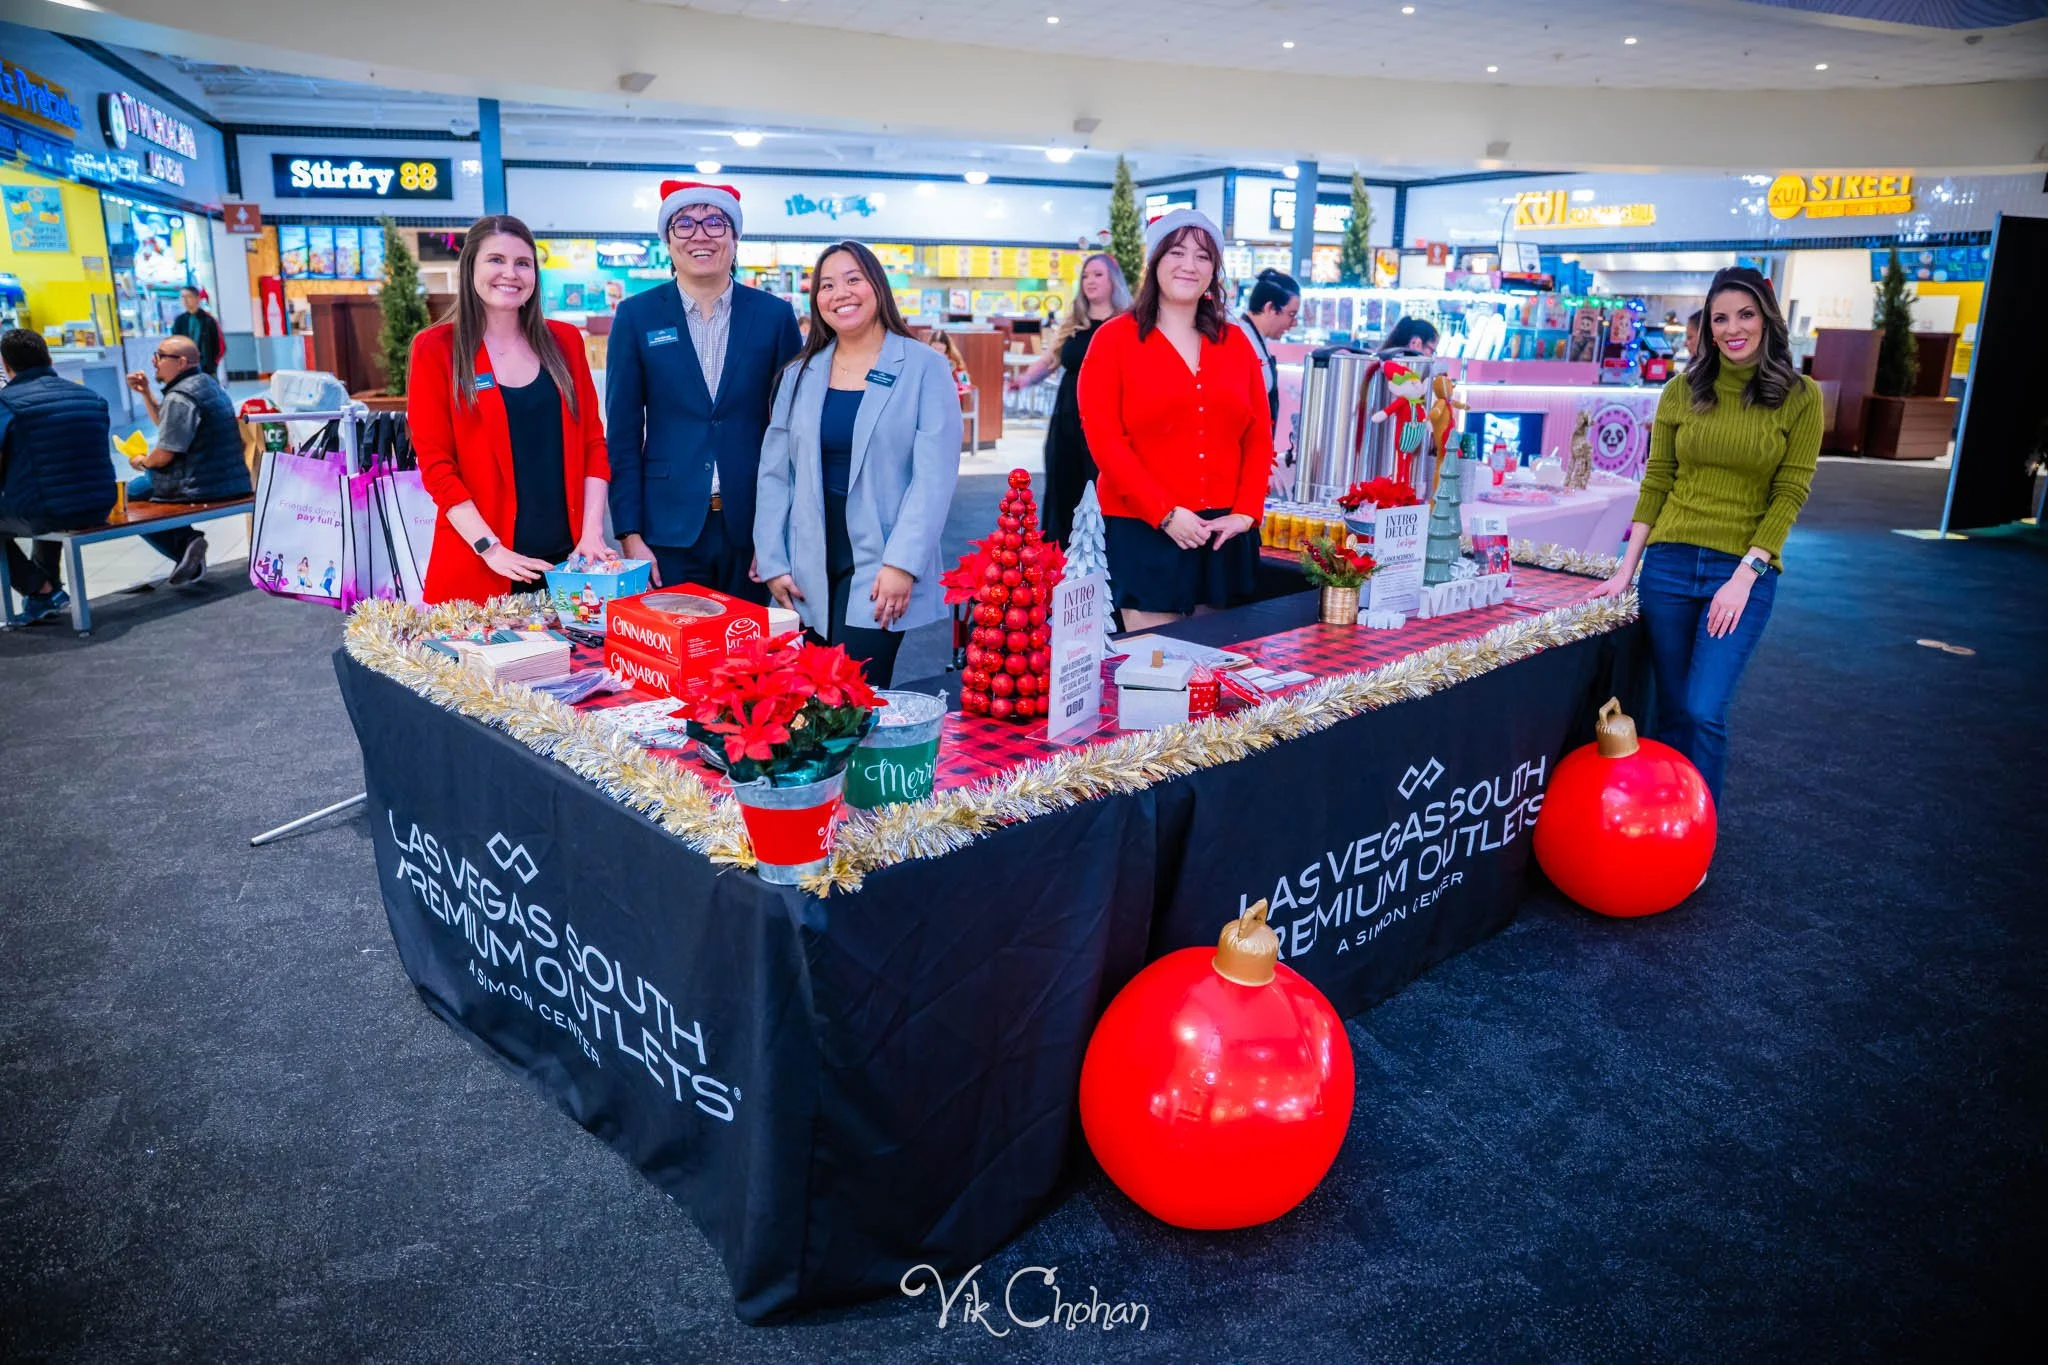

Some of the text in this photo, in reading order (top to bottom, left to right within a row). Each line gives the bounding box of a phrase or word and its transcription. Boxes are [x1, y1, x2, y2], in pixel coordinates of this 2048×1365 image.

[290, 159, 438, 195] Stirfry 88
[1515, 190, 1568, 225] KUI
[1772, 186, 1801, 206] KUI
[297, 513, 315, 524] pay
[317, 515, 333, 526] full
[1385, 523, 1418, 539] DEUCE
[1386, 513, 1418, 528] INTRO
[1064, 583, 1095, 608] INTRO
[1063, 601, 1094, 628] DEUCE
[612, 615, 672, 655] CINNABON
[610, 651, 671, 693] CINNABON
[1326, 801, 1446, 884] VEGAS
[1449, 755, 1546, 824] SOUTH
[1272, 793, 1545, 961] REMIUM OUTLETS
[1336, 871, 1464, 955] A SIMON CENER
[388, 809, 708, 1065] LAS VEGAS SOUTH
[468, 959, 601, 1068] A SIMON CENTER
